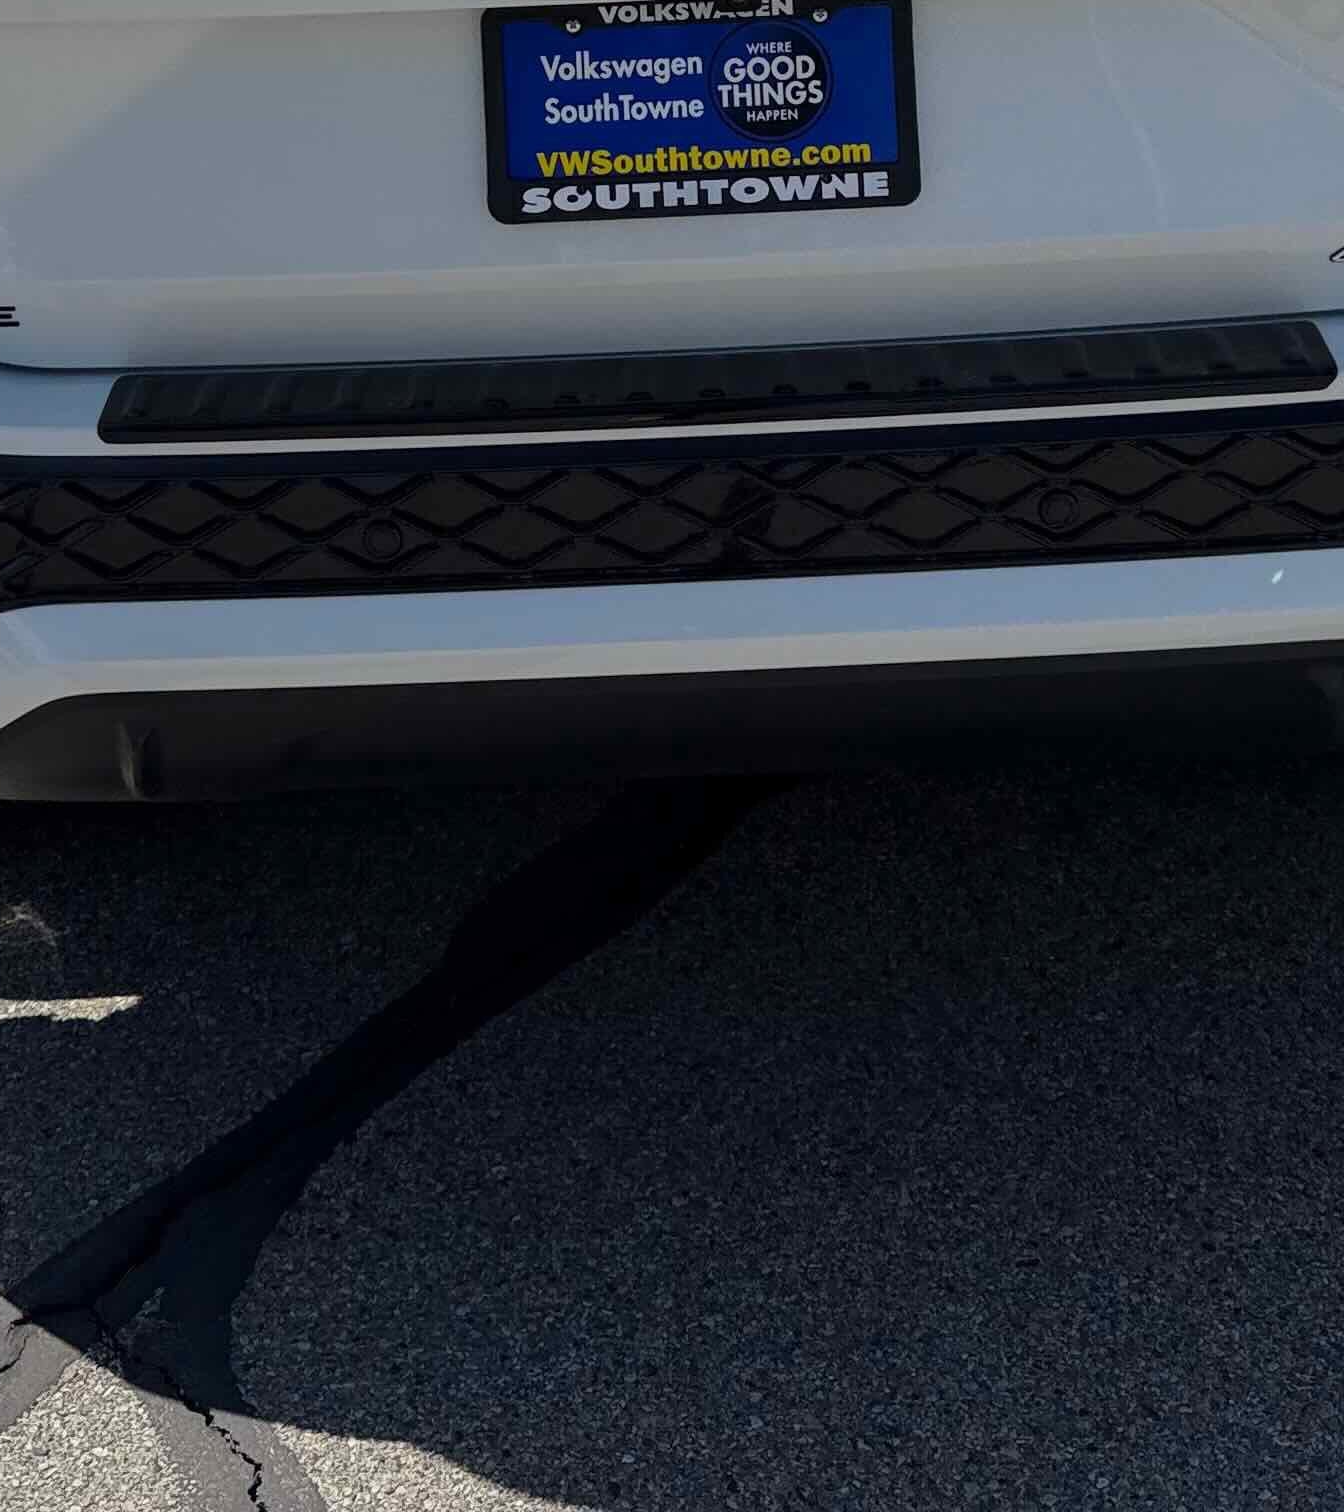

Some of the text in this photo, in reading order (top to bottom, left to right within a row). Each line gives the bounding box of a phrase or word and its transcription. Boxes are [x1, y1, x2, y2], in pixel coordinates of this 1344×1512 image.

[745, 40, 793, 56] WHERE
[540, 50, 704, 86] Volkswagen
[723, 55, 816, 84] GOOD
[544, 93, 705, 125] SouthTowne
[717, 79, 825, 109] THINGS
[745, 108, 800, 124] HAPPEN
[536, 143, 872, 179] VWSouthtowne.com
[521, 171, 890, 215] SOUTHTOWNE
